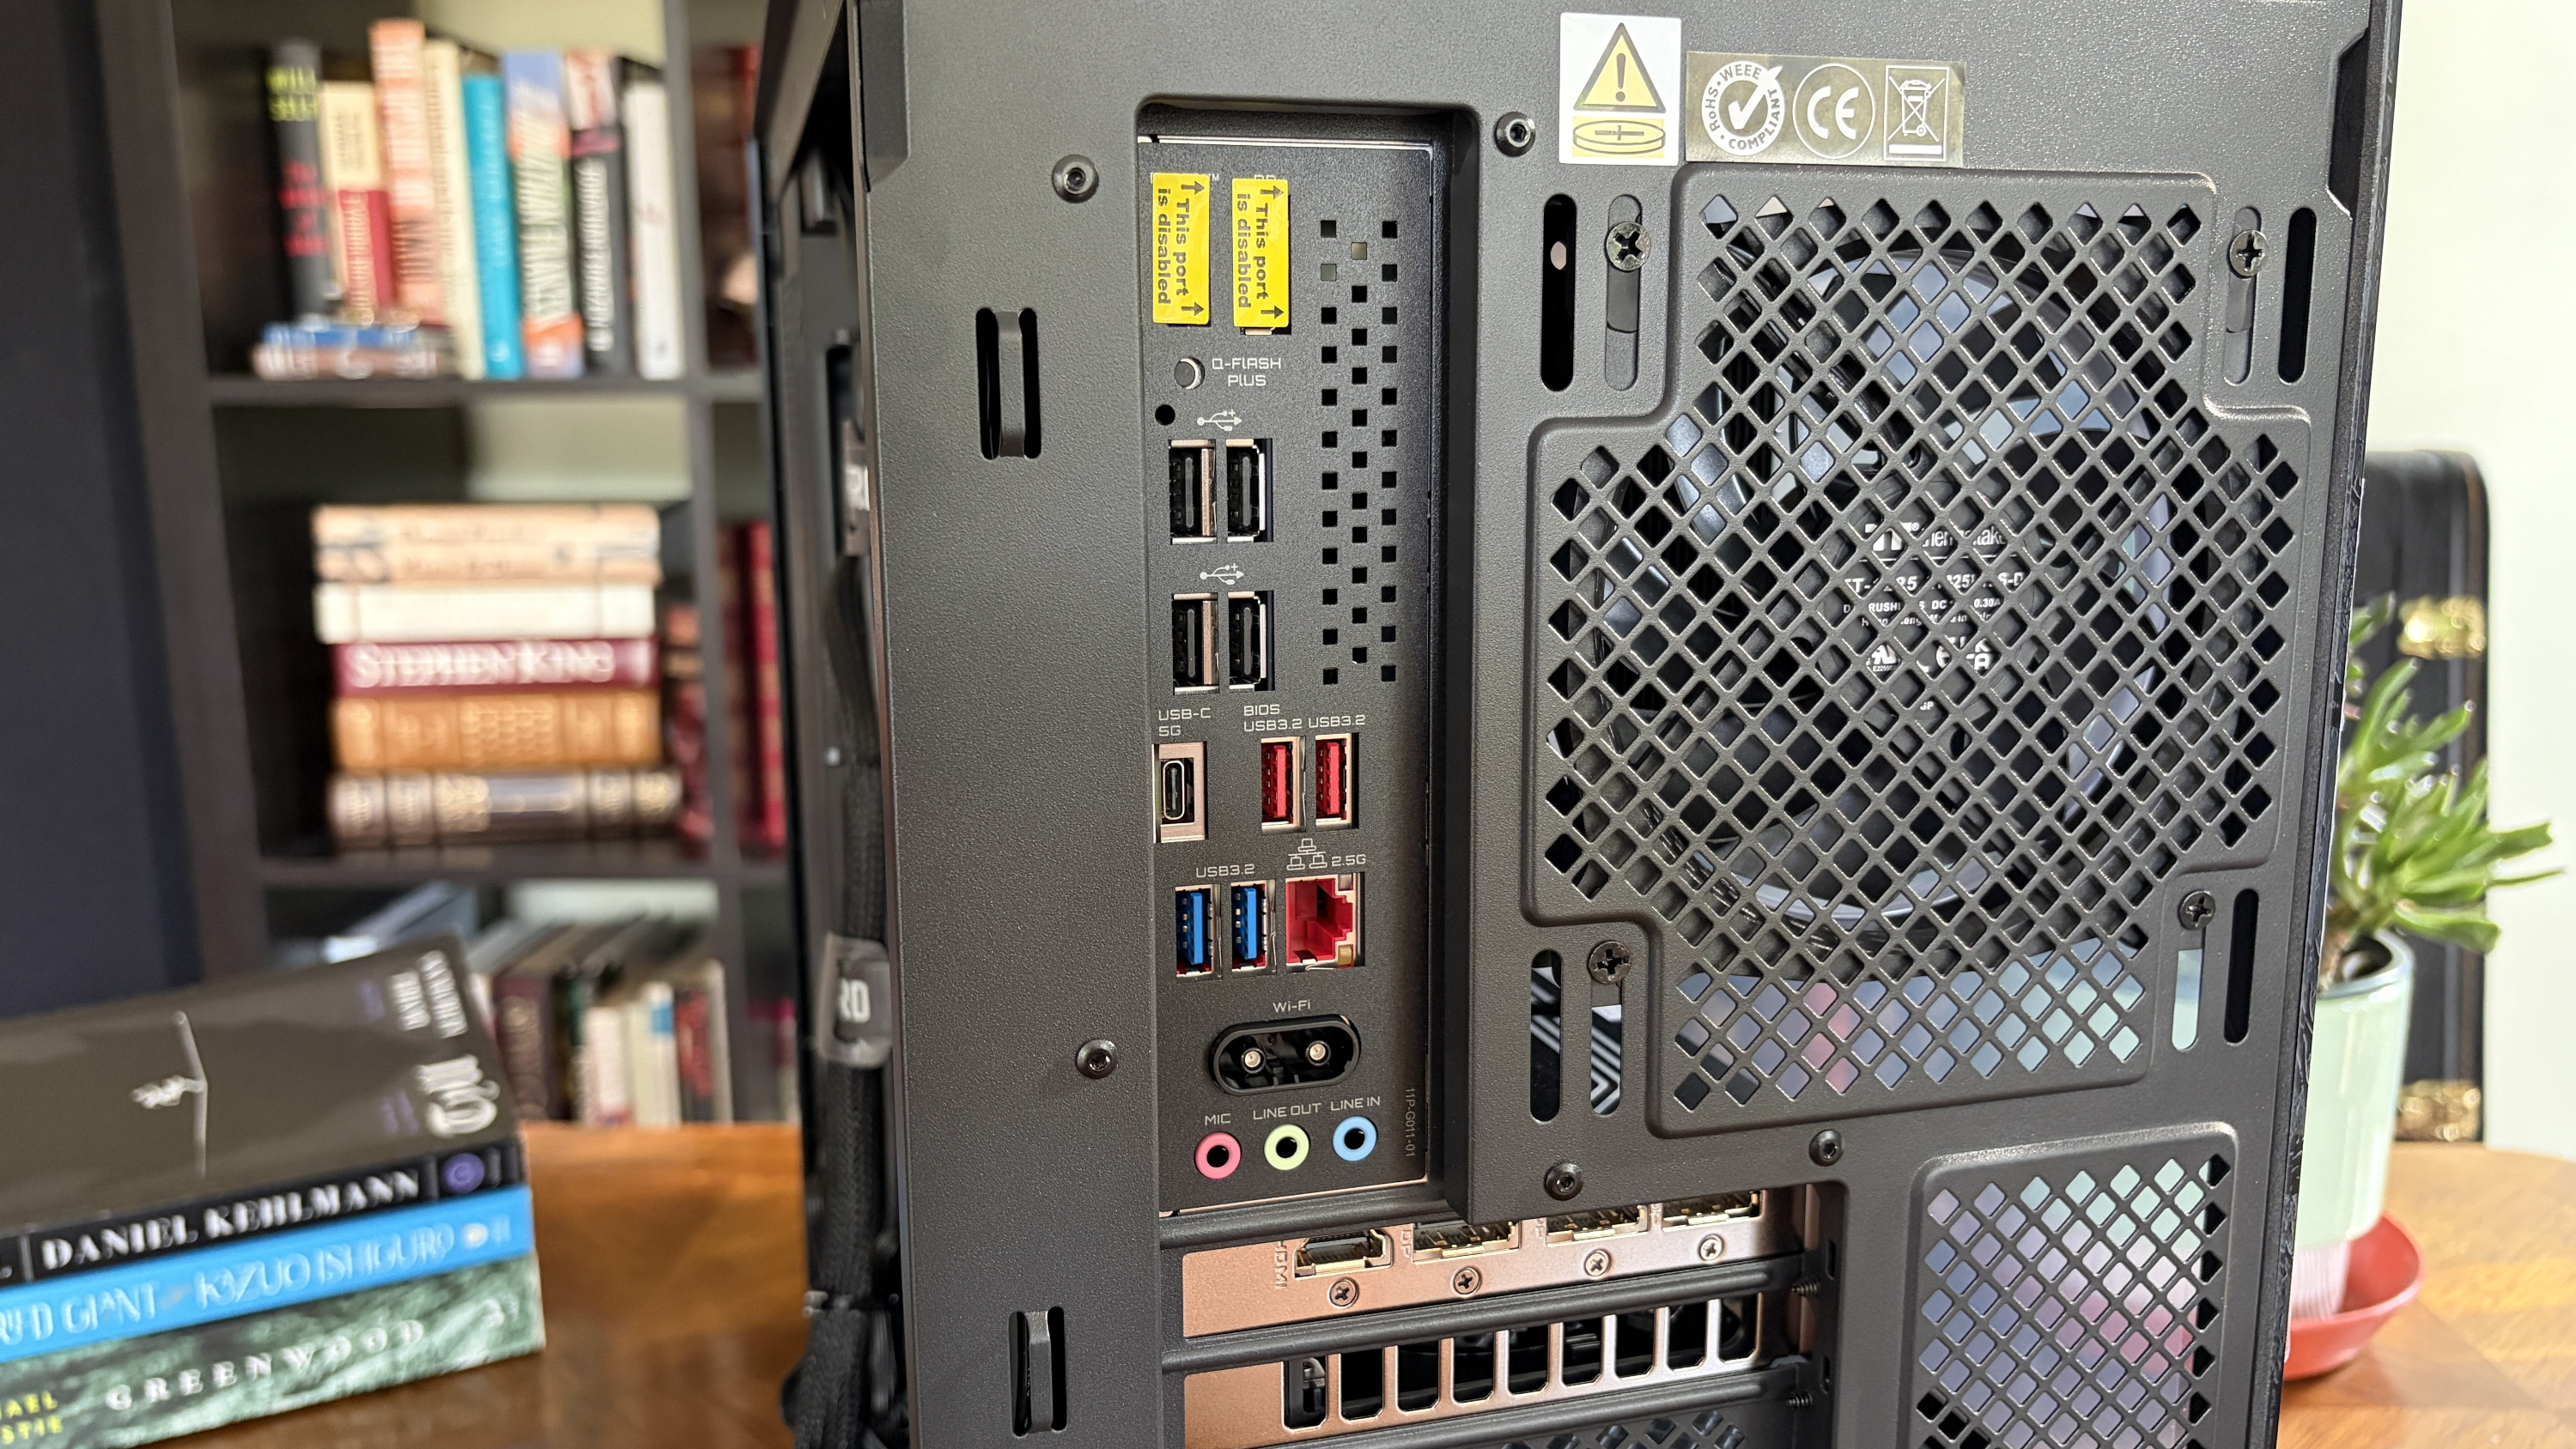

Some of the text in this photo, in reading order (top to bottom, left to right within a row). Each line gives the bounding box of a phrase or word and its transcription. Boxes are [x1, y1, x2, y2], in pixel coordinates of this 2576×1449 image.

[1719, 64, 1762, 82] WEEE
[1728, 88, 1780, 150] COMPLIANT
[1157, 187, 1171, 305] is disabled
[1173, 198, 1190, 297] This port
[1237, 193, 1251, 309] is disabled
[1253, 203, 1269, 300] This port
[1158, 707, 1212, 721] USB-C
[1243, 704, 1280, 717] BIOS
[1244, 718, 1303, 732] USB3.2
[1308, 714, 1366, 729] USB3.2
[1332, 853, 1367, 867] 2.5G
[1195, 864, 1255, 879] USB3.2
[1273, 1000, 1311, 1014] Wi-Fi
[1253, 1102, 1322, 1120] LINE OUT
[1330, 1095, 1381, 1111] LINE IN
[1204, 1113, 1231, 1126] MIC
[41, 1213, 199, 1271] DANIEL
[204, 1170, 419, 1239] KEHLMANN
[104, 1319, 425, 1411] GREENWOOD
